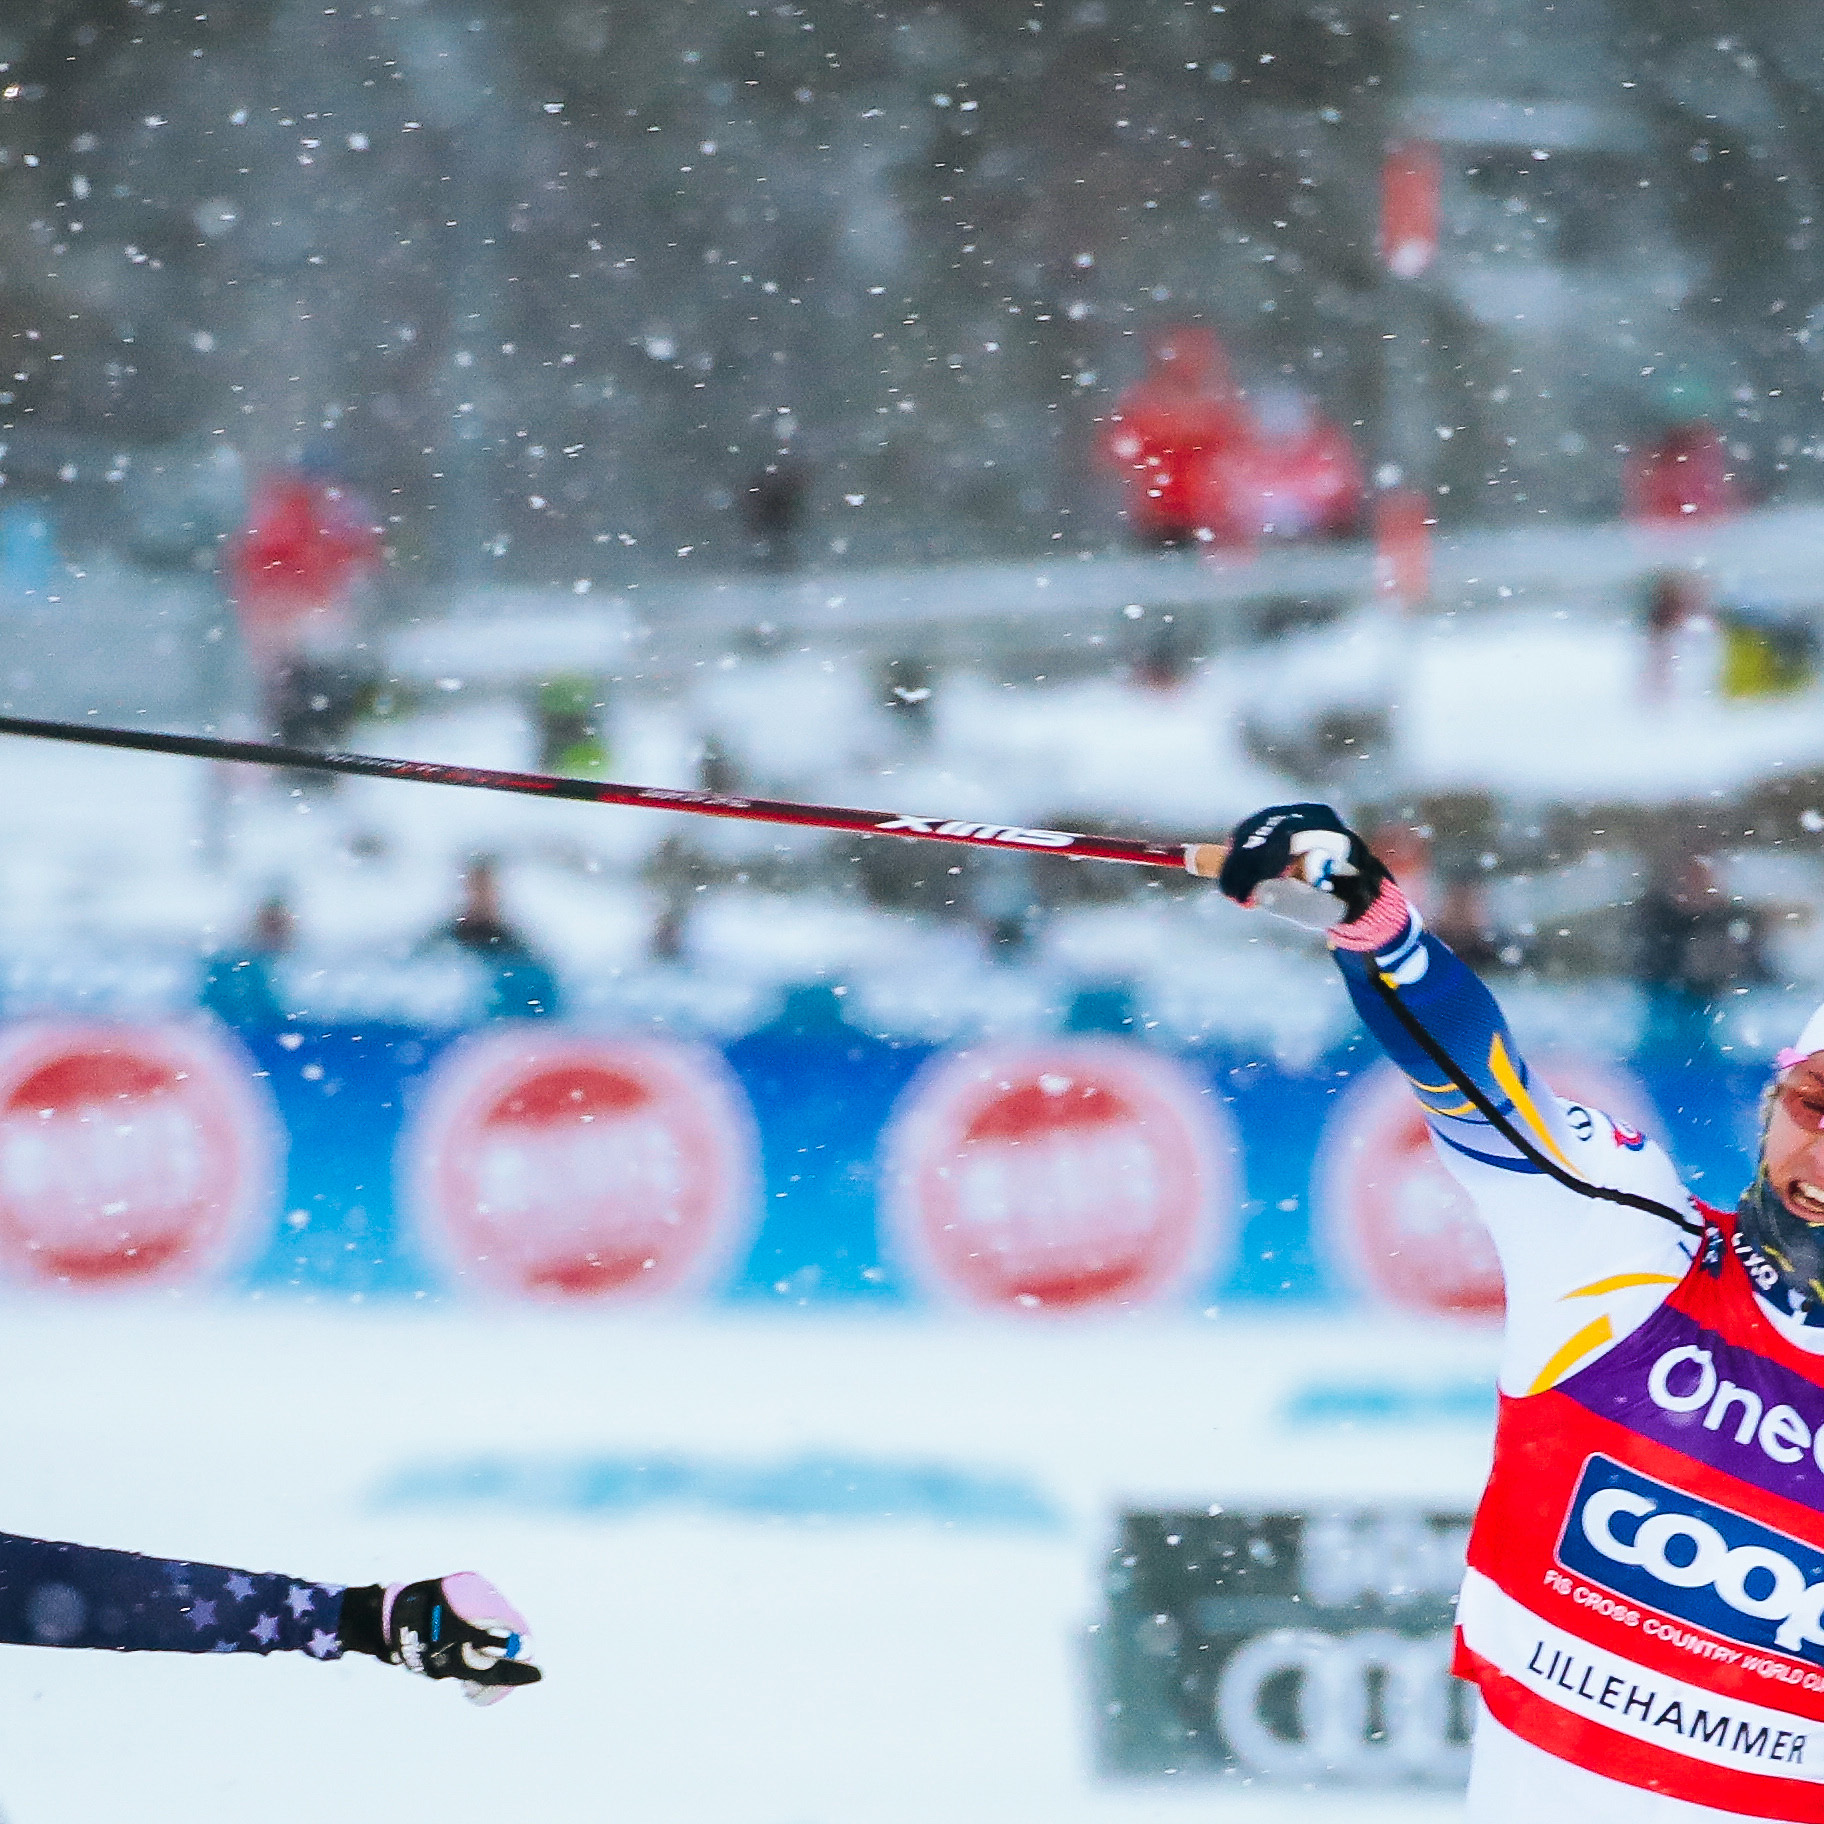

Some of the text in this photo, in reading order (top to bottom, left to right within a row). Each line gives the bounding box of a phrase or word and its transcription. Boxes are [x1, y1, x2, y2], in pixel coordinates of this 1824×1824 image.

[1543, 1569, 1573, 1596] FIS
[1572, 1586, 1641, 1628] CROSS
[1642, 1618, 1743, 1665] COUNTRY
[1741, 1653, 1805, 1685] WORLD
[1527, 1641, 1806, 1765] LILLEHAMMER
